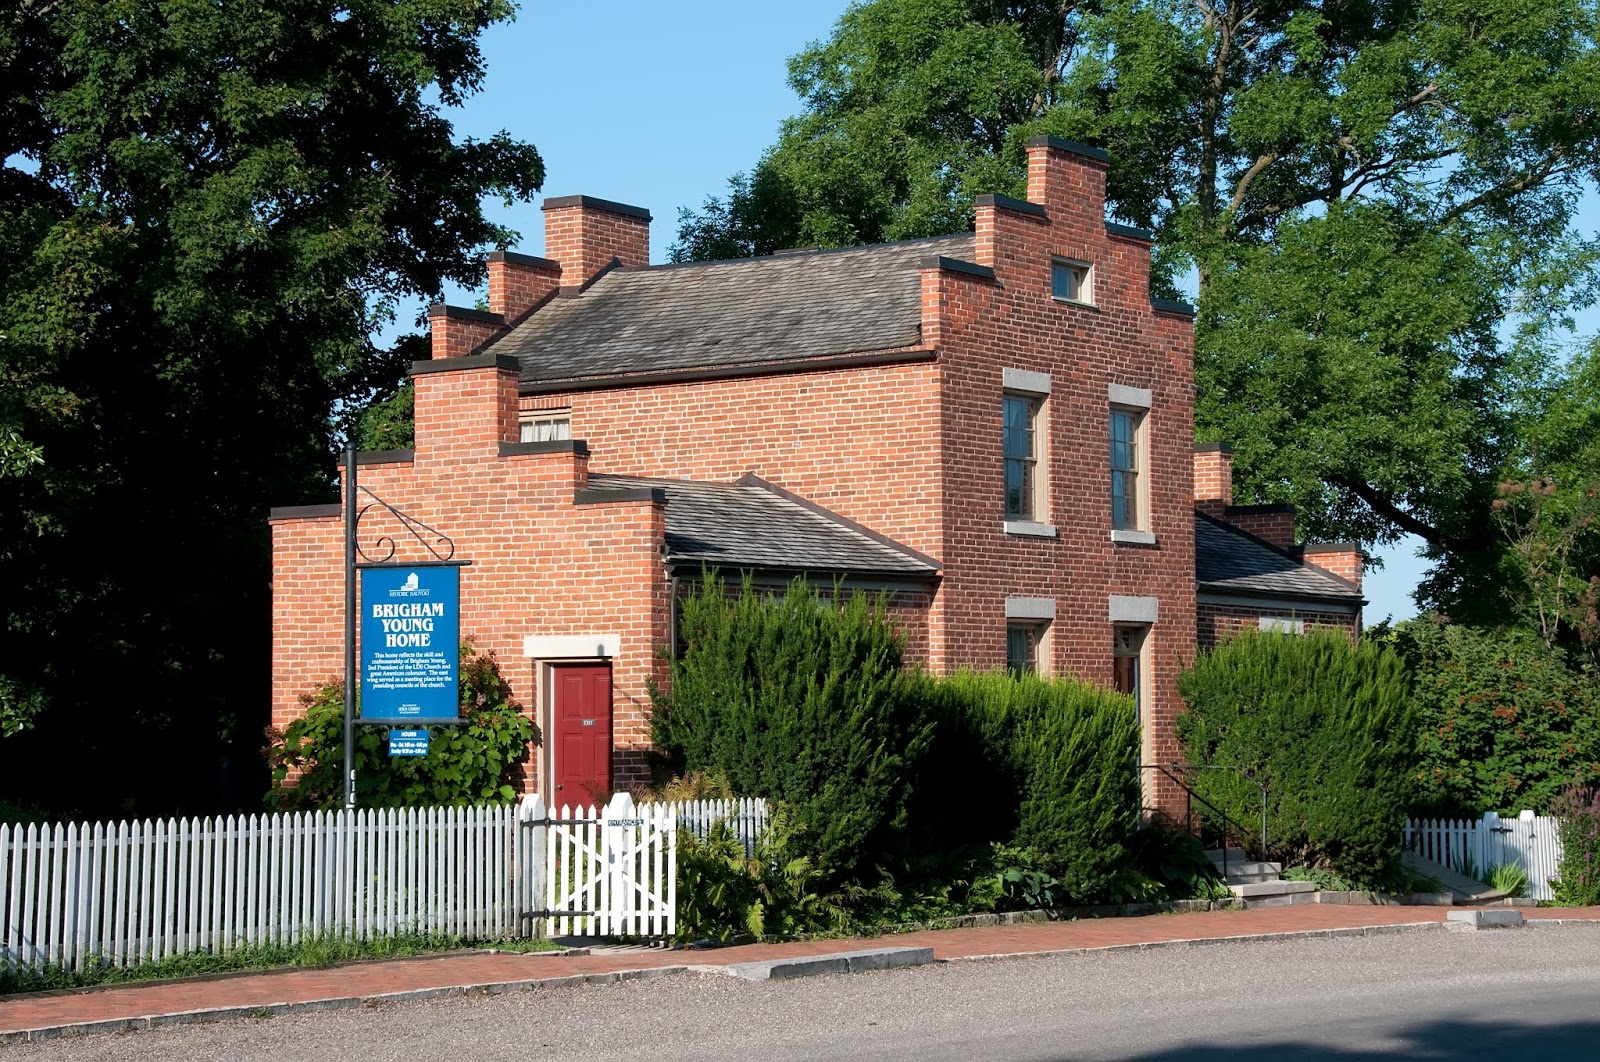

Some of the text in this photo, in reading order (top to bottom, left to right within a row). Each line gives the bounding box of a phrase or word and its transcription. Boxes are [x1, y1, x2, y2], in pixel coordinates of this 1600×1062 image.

[372, 602, 444, 617] BRIGHAM
[382, 618, 434, 632] YOUNG
[386, 633, 431, 647] HOME
